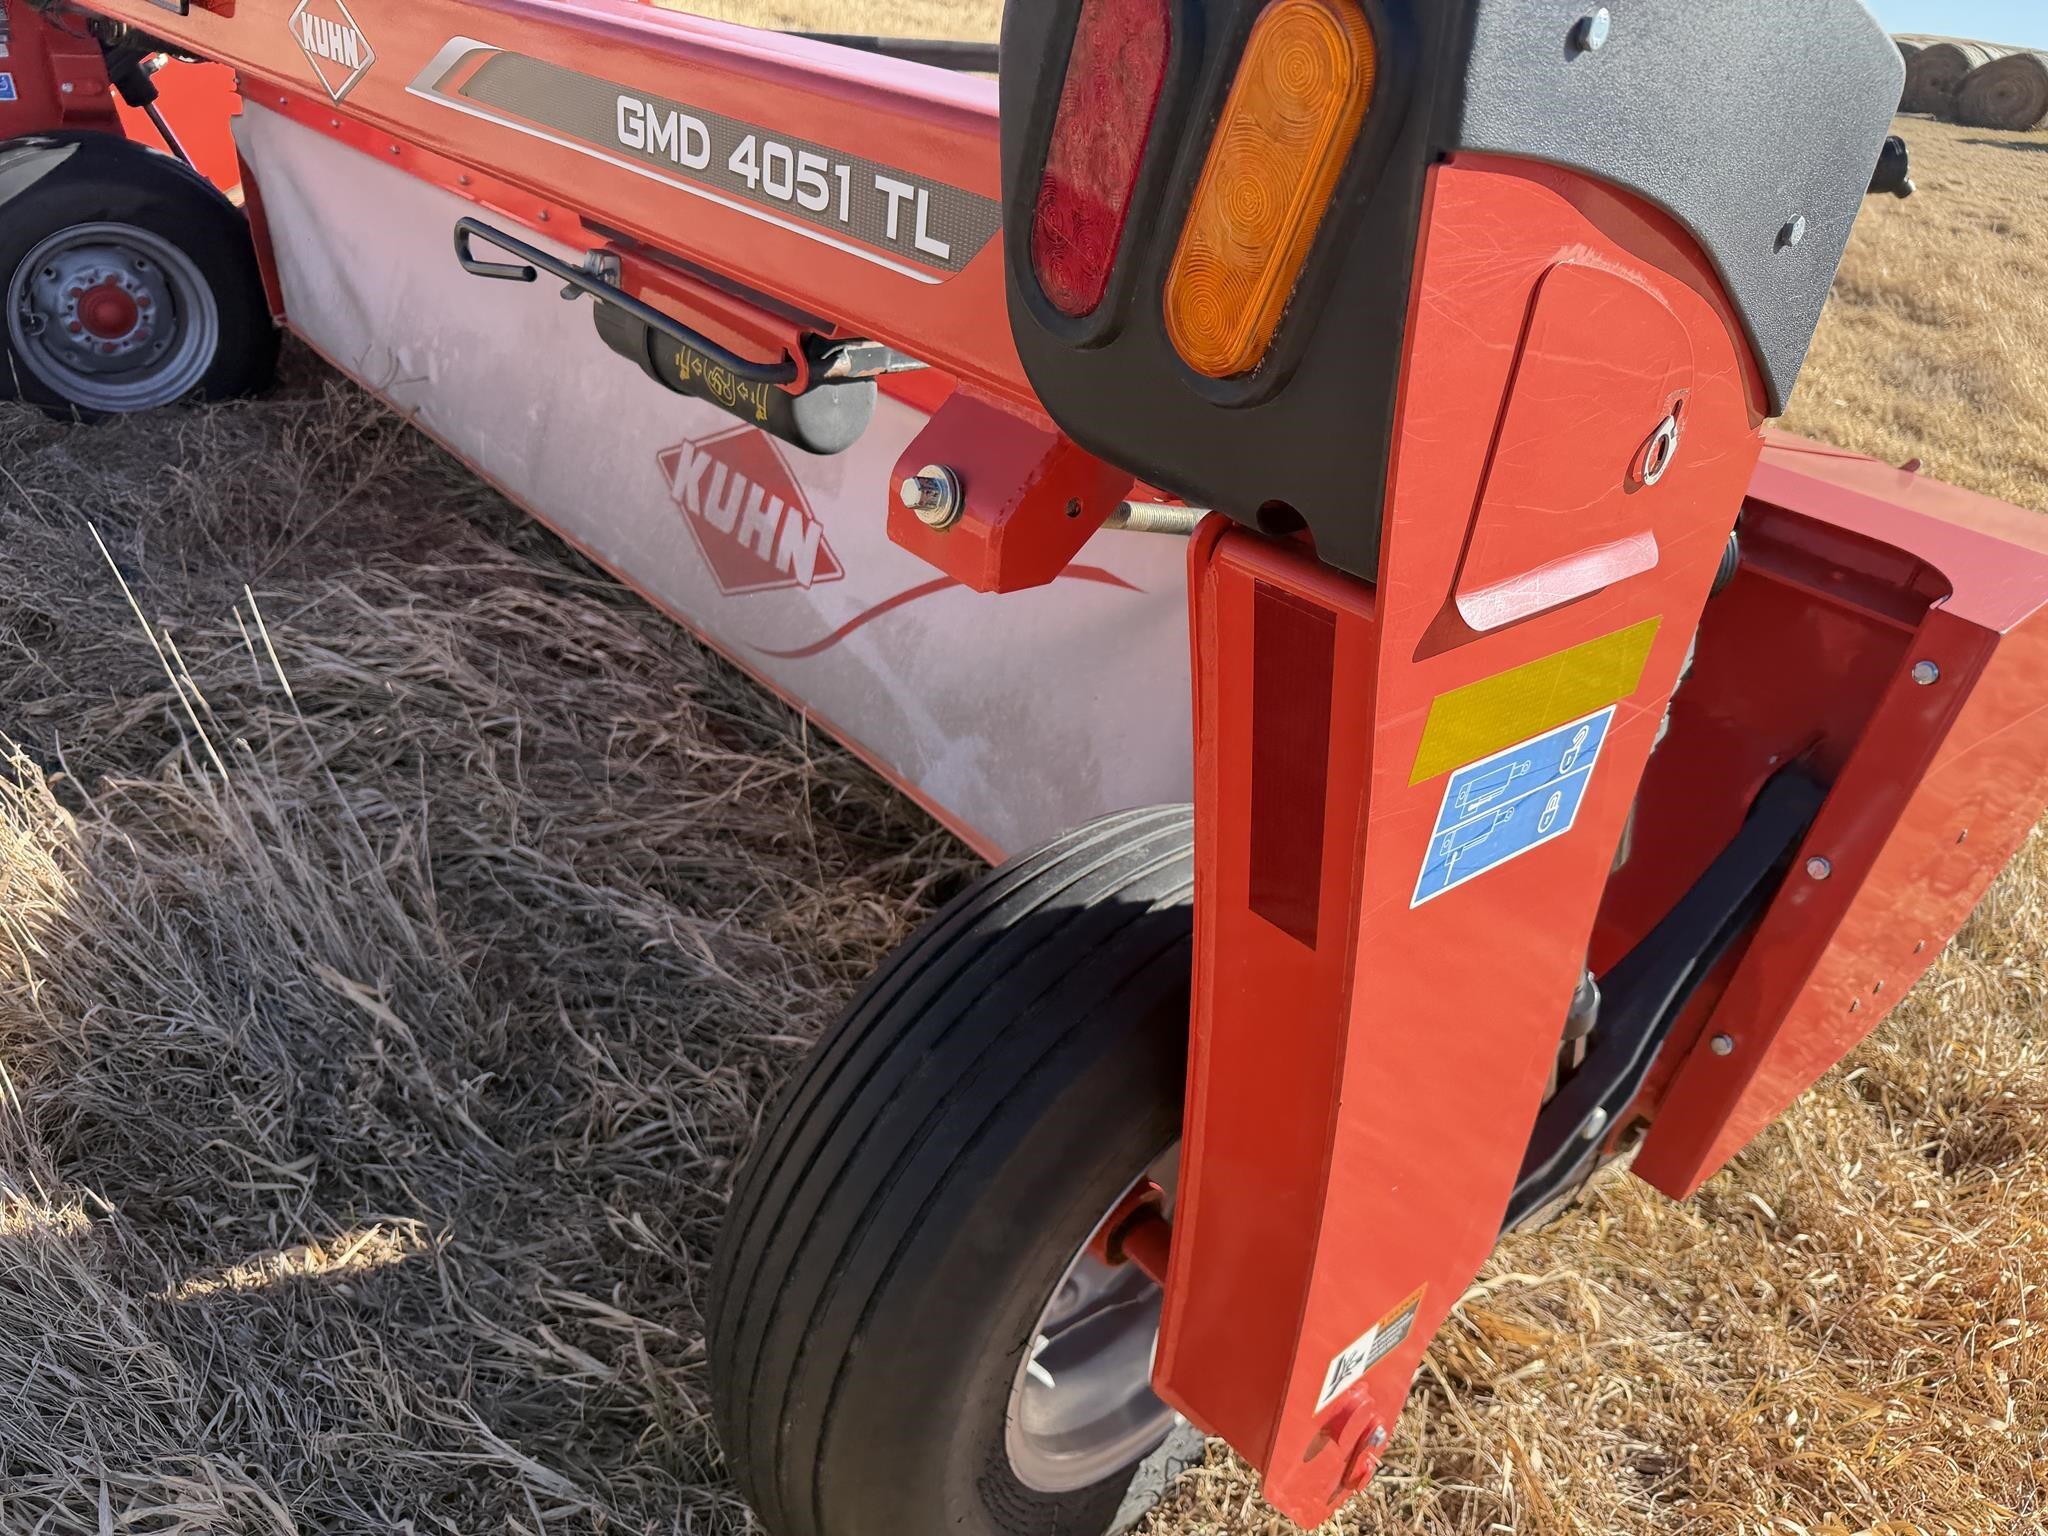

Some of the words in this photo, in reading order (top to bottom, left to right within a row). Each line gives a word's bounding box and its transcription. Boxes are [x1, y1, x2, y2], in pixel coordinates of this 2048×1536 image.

[300, 11, 360, 70] KUHN
[616, 94, 712, 171] GMD
[728, 134, 851, 223] 4051
[874, 175, 951, 260] TL
[671, 439, 823, 587] KUHN
